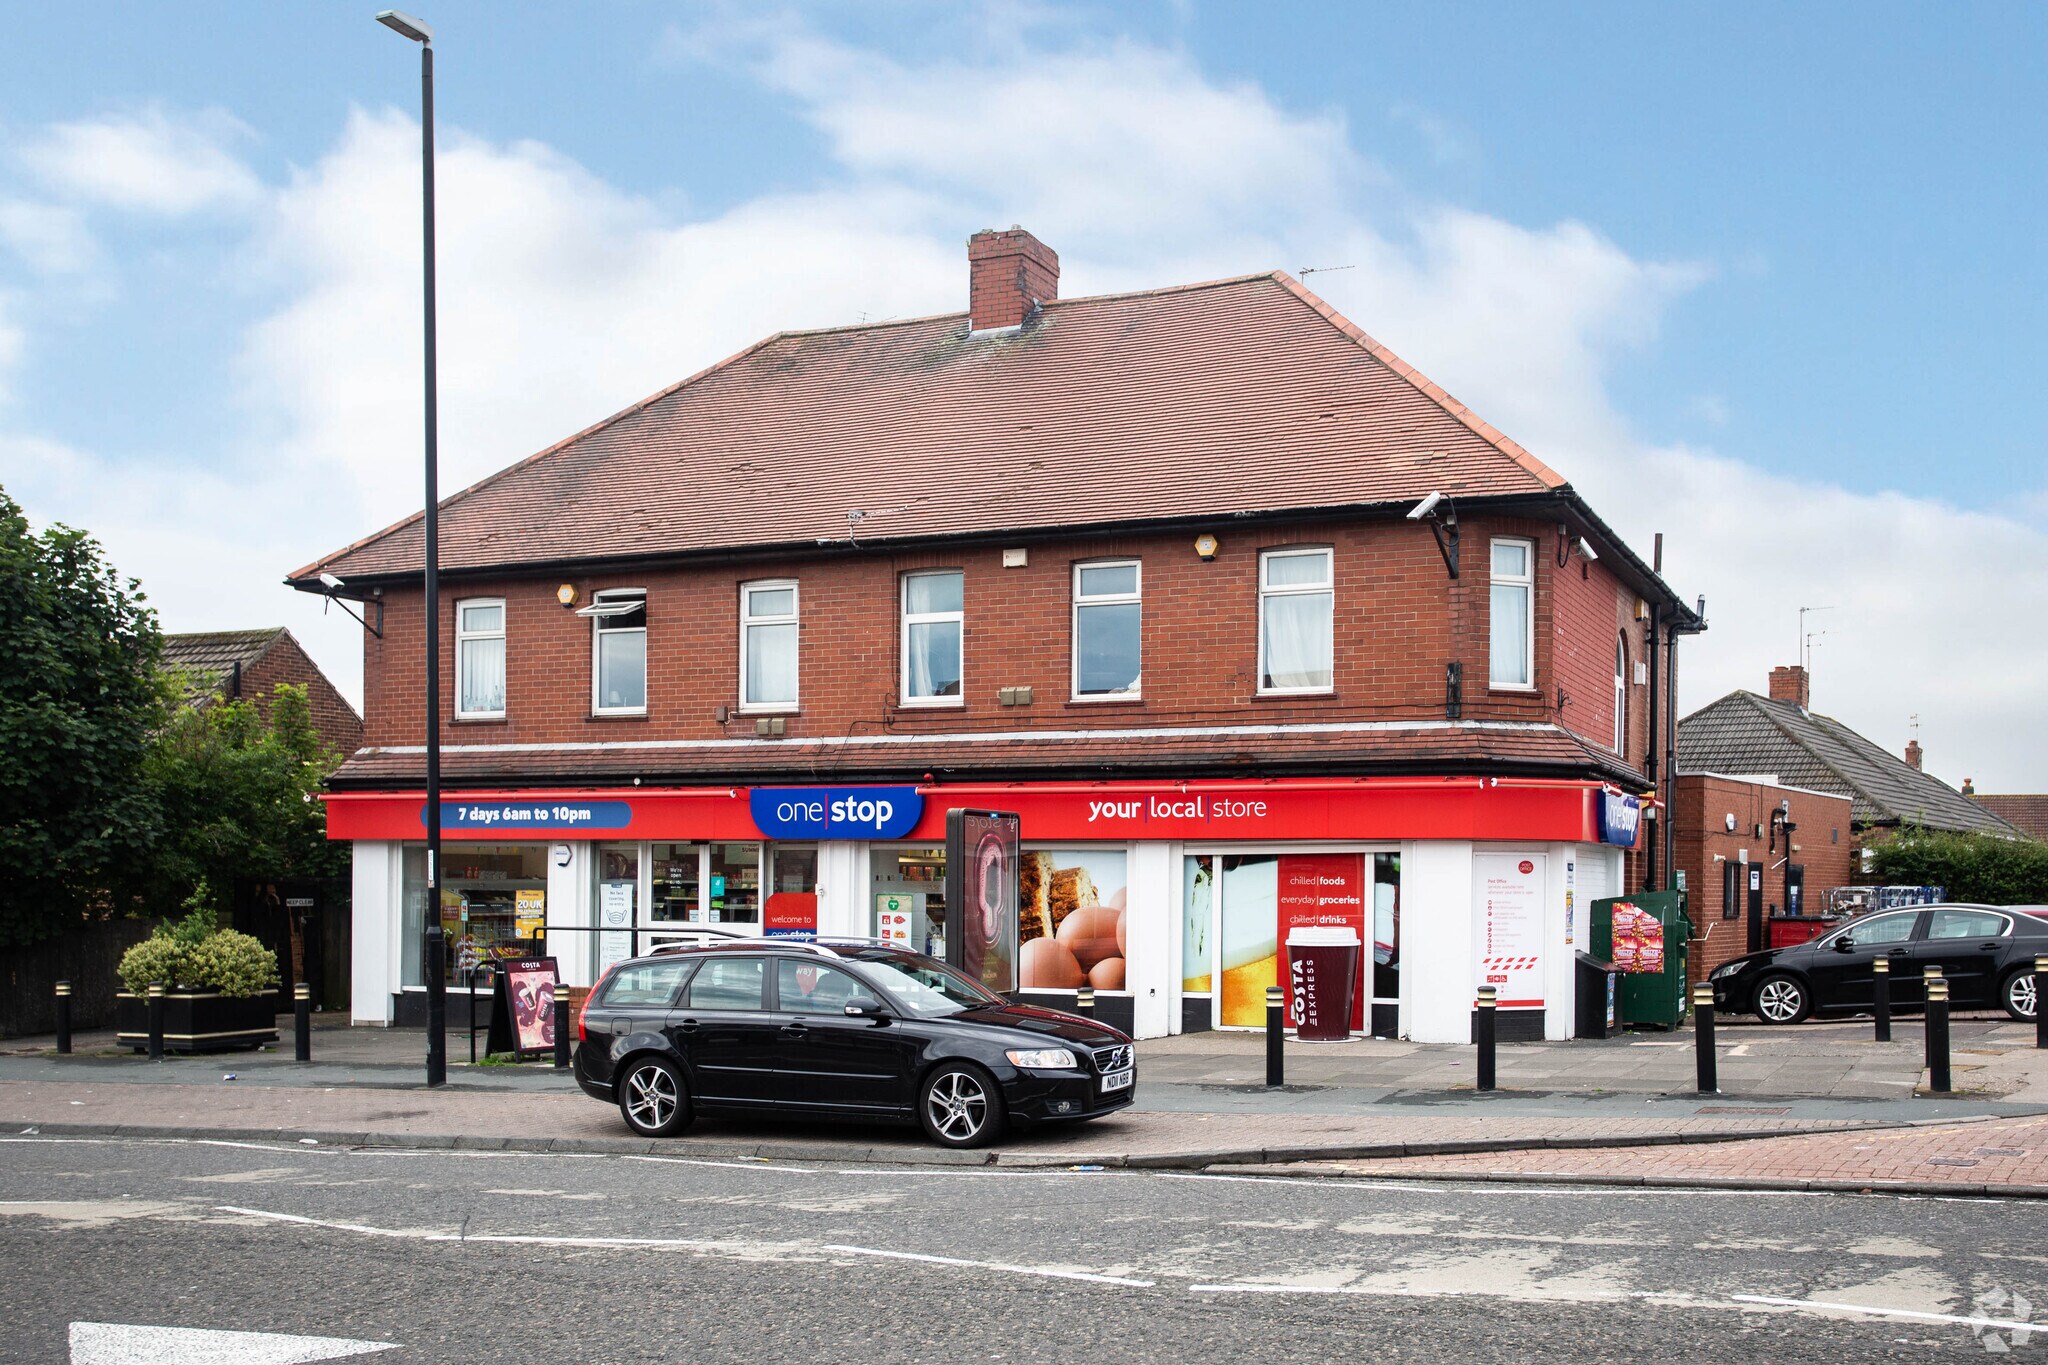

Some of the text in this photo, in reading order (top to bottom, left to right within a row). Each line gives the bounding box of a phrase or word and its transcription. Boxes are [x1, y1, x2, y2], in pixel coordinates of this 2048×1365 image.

[458, 806, 591, 823] 7 days 6am to 10pm
[777, 795, 893, 830] one stop
[1088, 795, 1267, 822] your local store
[1610, 801, 1637, 841] one stop
[1290, 876, 1345, 885] chilled foods
[517, 900, 543, 909] 20 UK
[1281, 895, 1360, 905] everyday groceries
[771, 915, 812, 924] welcome to
[1289, 914, 1347, 924] chilled drinks
[796, 967, 813, 976] way
[1292, 959, 1306, 1025] COSTA
[1306, 959, 1317, 1016] EXPRESS
